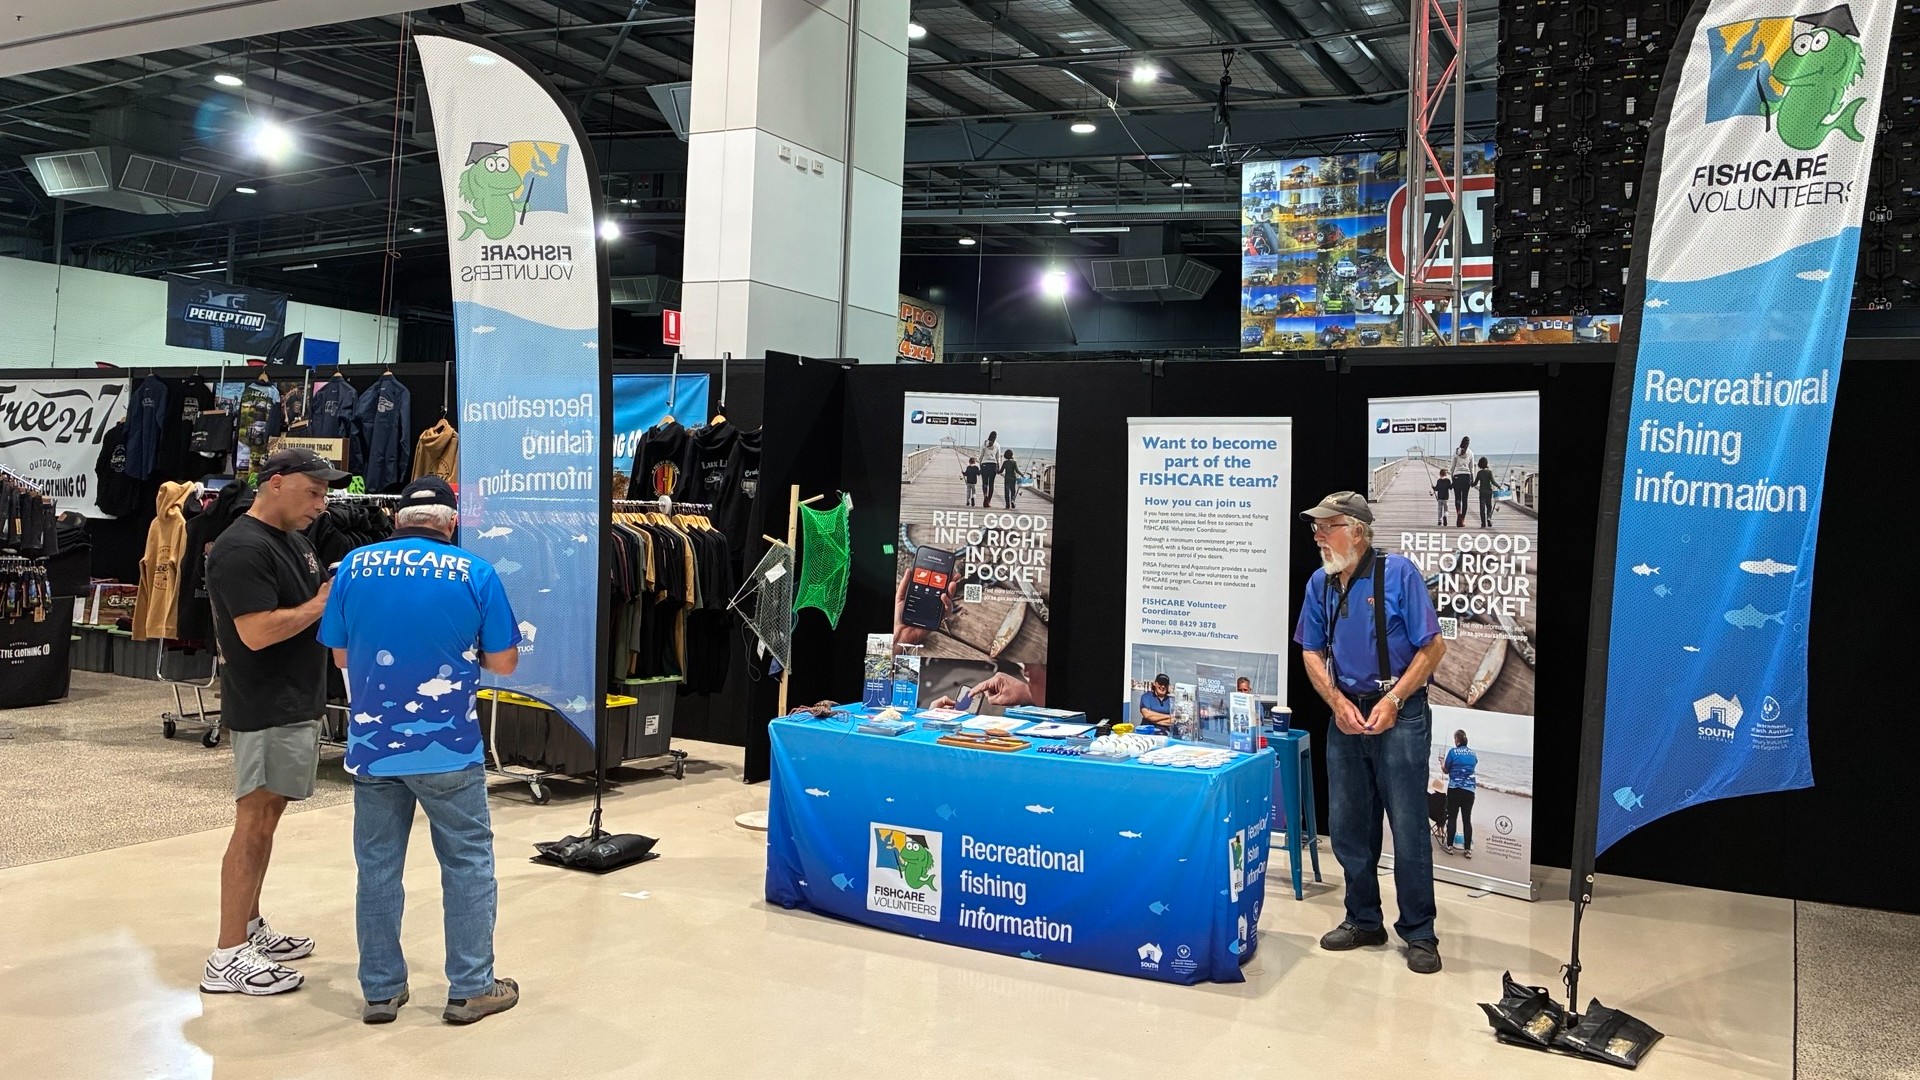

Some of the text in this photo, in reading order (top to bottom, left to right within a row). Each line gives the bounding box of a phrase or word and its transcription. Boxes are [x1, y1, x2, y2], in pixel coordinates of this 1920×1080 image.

[1692, 154, 1828, 186] FISHCARE
[901, 302, 938, 328] PRO
[1645, 369, 1828, 406] Recreational
[316, 443, 333, 451] TRACK
[1142, 437, 1277, 450] Want to become
[1639, 419, 1742, 465] fishing
[29, 459, 61, 471] OUTDOOR
[1164, 455, 1251, 471] part of the
[76, 474, 87, 497] CO
[1139, 473, 1279, 488] FISHCARE team?
[1635, 468, 1806, 512] information
[1144, 497, 1168, 506] How
[1172, 500, 1191, 509] you
[1216, 498, 1236, 509] join
[933, 510, 1047, 531] REEL GOOD
[935, 528, 1047, 549] INFO RIGHT
[1401, 532, 1531, 554] REEL GOOD
[351, 549, 472, 574] FISHCARE
[966, 546, 1046, 566] IN YOUR
[1404, 552, 1531, 575] NFO RIGHT
[351, 567, 469, 582] VOLUNTEER
[965, 563, 1046, 583] POCKET
[1438, 573, 1530, 596] IN YOUR
[1142, 598, 1227, 609] FISHCARE Volunteer
[1142, 607, 1191, 616] Coordinator
[1437, 593, 1531, 617] POCKET
[1141, 628, 1239, 640] www.pir.sa.gov.au/fishcare
[14, 646, 42, 658] CLOTHING
[1698, 727, 1735, 739] SOUTH
[961, 835, 1084, 873] Recreational
[875, 886, 925, 902] FISHCARE
[960, 870, 1026, 905] fishing
[874, 896, 937, 916] VOLUNTEERS
[959, 903, 1072, 944] information
[1140, 961, 1159, 969] SOUTH
